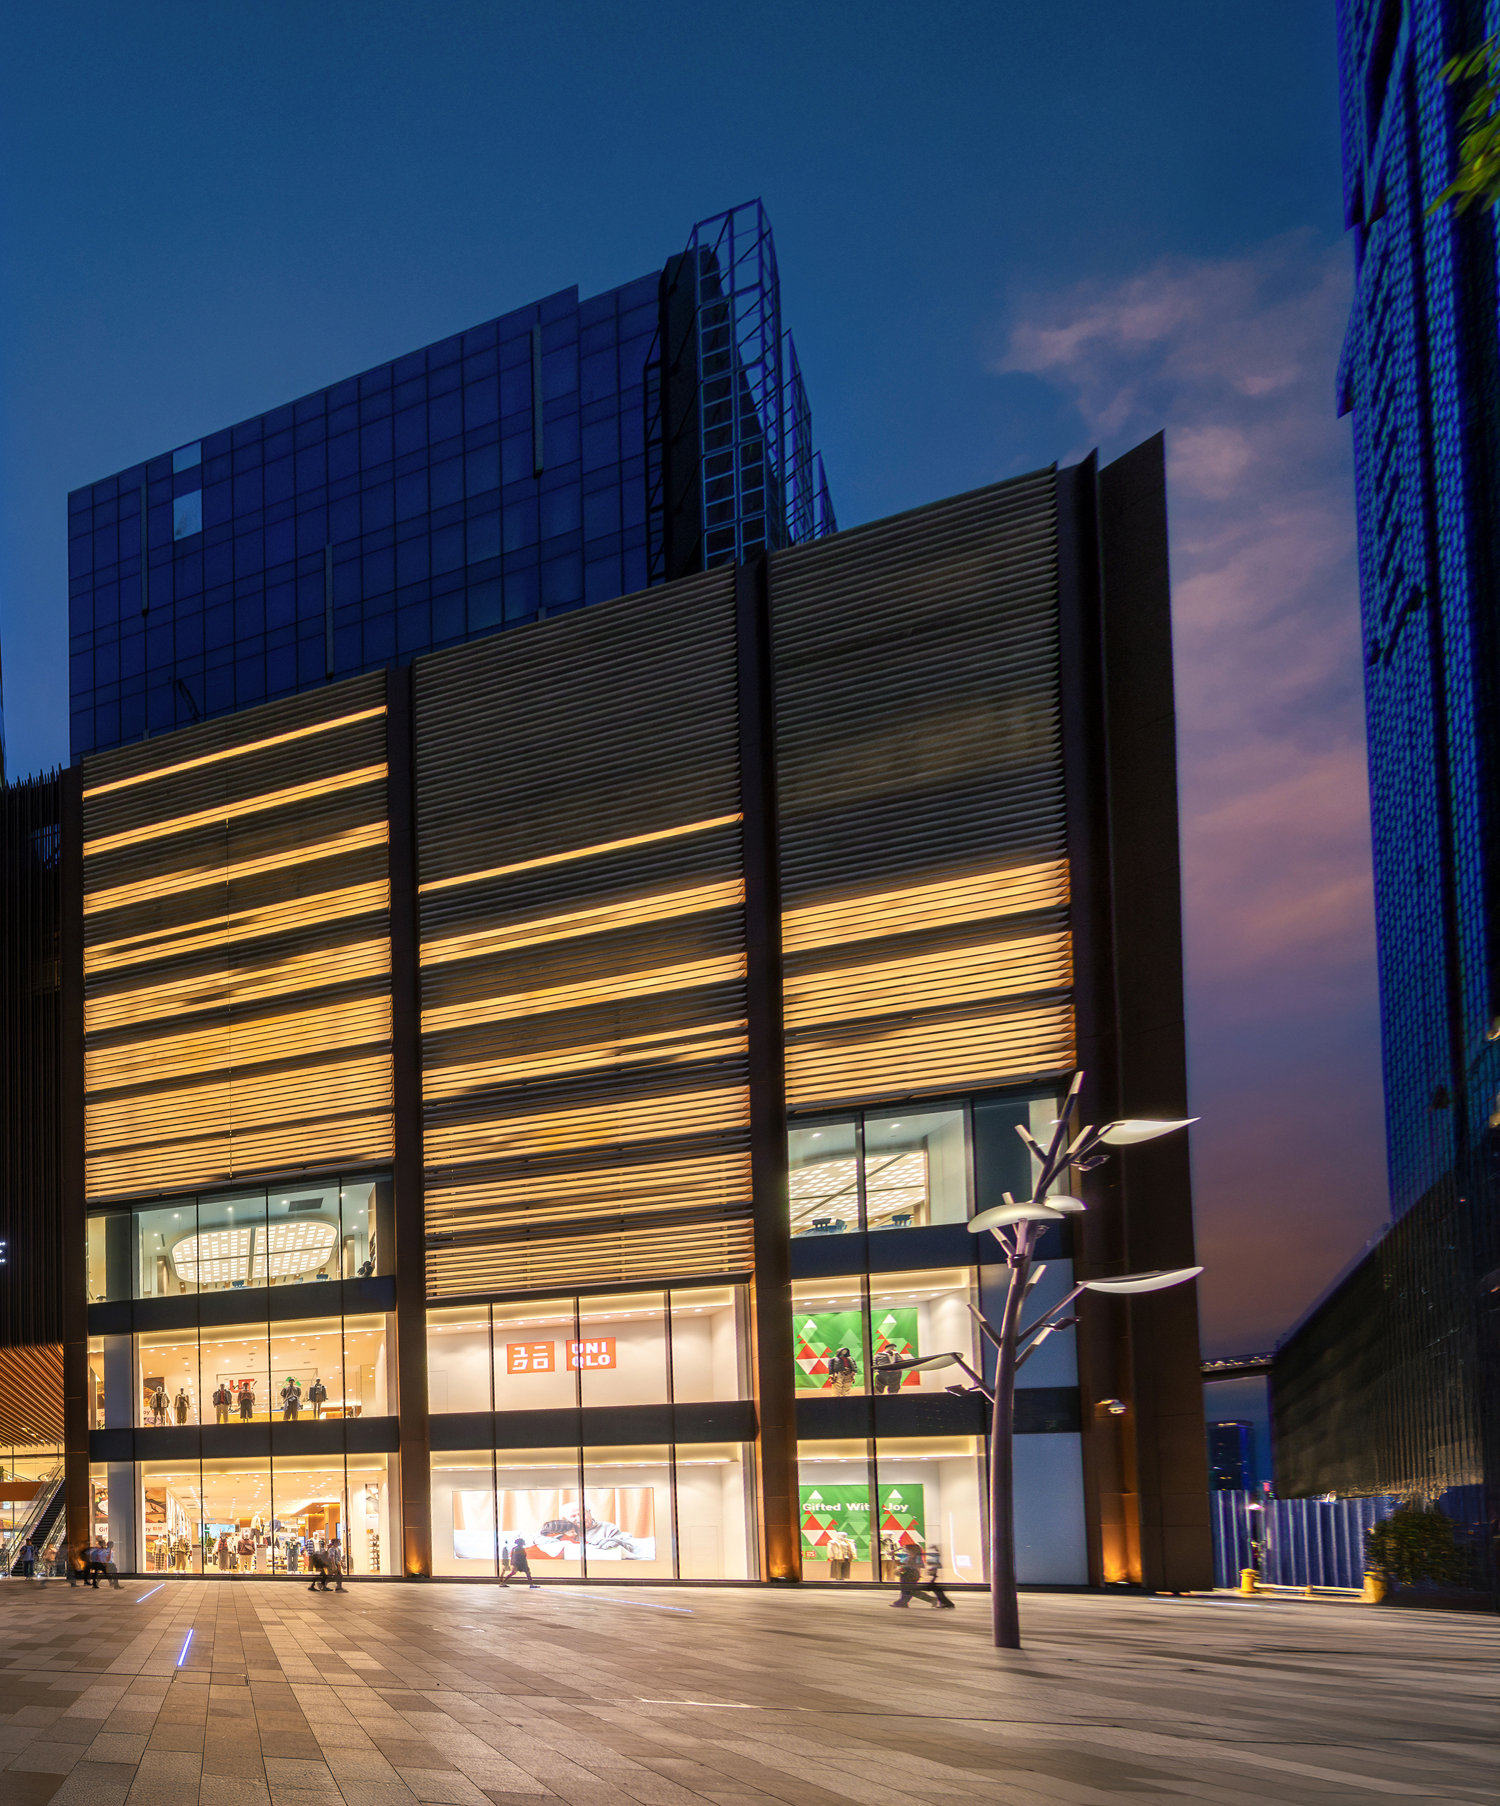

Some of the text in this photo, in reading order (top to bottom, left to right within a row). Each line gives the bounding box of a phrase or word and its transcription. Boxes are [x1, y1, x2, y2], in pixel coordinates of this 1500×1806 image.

[802, 1502, 909, 1513] Gifted Wit Joy
